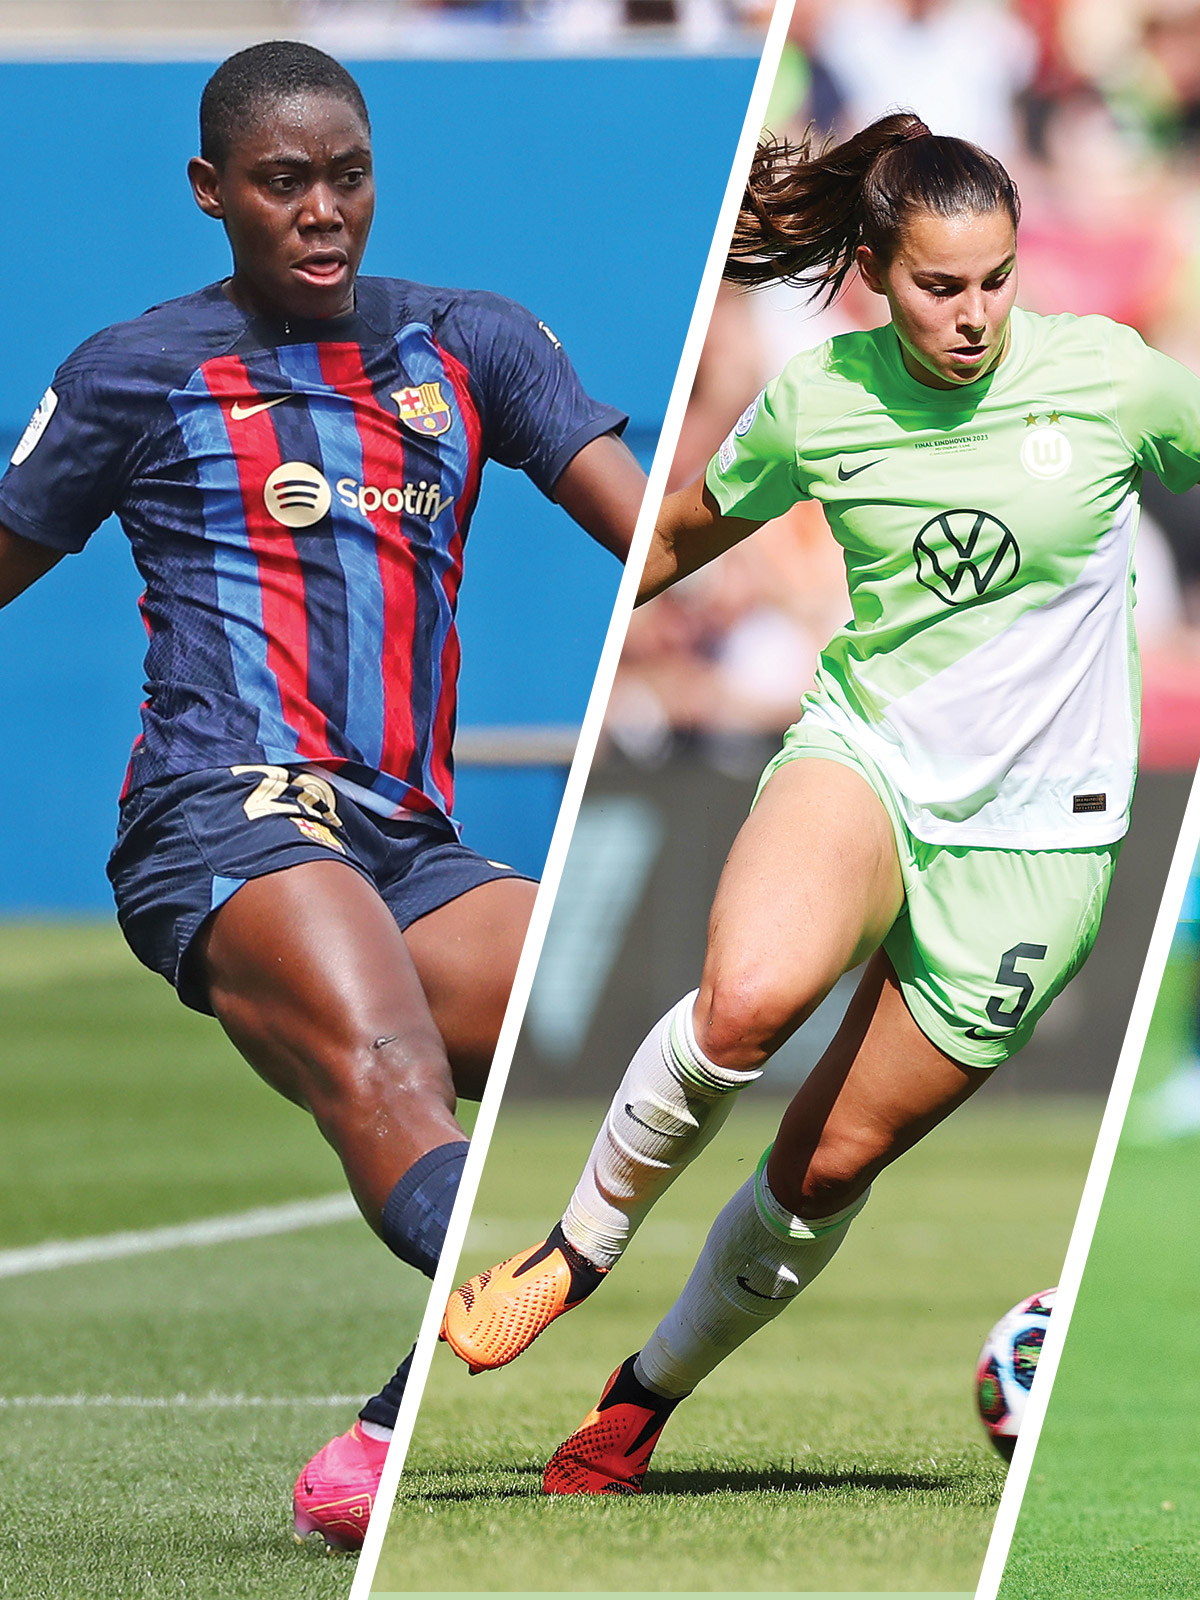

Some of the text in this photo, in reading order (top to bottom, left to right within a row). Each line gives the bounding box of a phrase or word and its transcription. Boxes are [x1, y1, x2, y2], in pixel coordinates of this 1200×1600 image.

[914, 441, 933, 449] FINAL
[934, 436, 972, 447] EINDHOVEN
[973, 434, 989, 442] 2023
[336, 478, 454, 522] Spotify
[985, 942, 1048, 1028] 5
